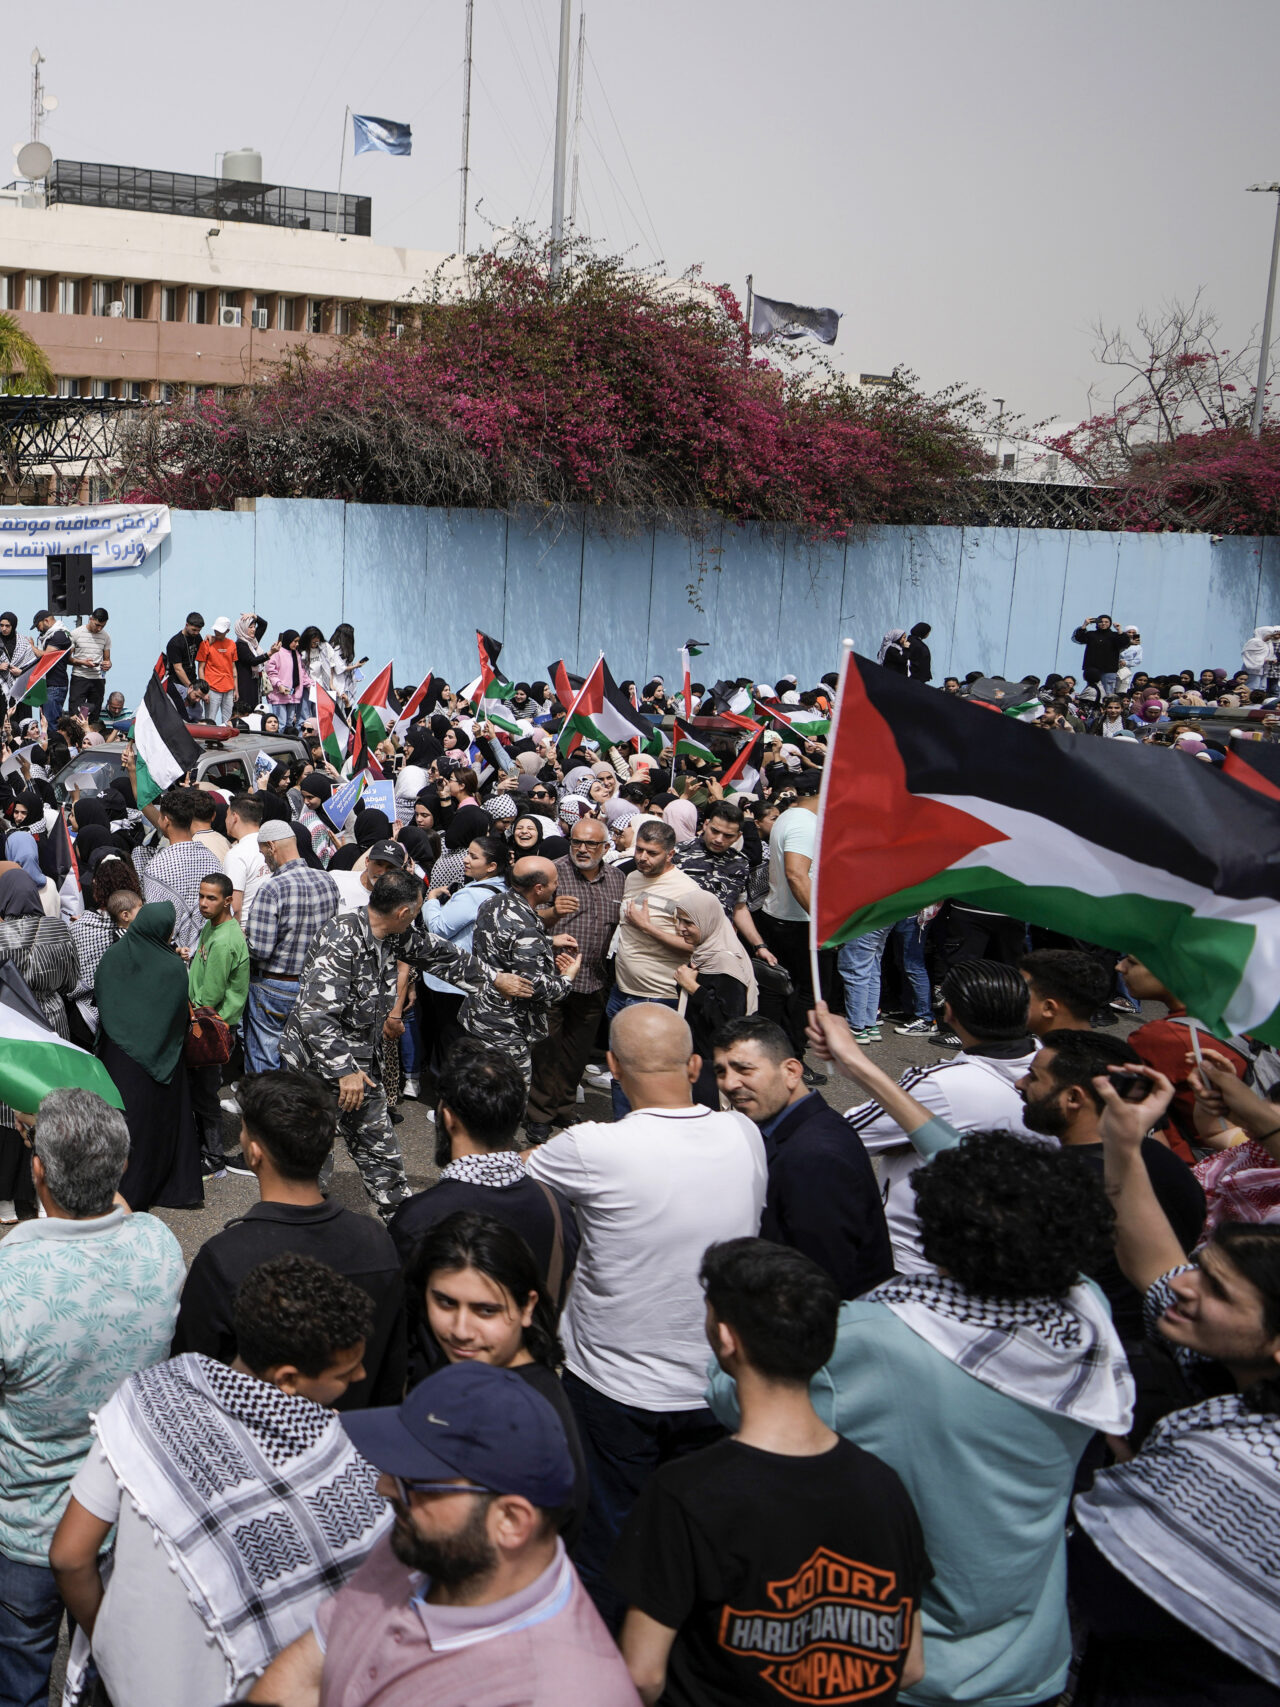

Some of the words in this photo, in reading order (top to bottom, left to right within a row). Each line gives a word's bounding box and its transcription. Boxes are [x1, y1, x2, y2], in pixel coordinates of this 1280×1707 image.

[55, 516, 111, 535] معاقبة
[116, 513, 159, 533] نرفض
[787, 1557, 876, 1609] MOTOR
[731, 1605, 904, 1654] HARLEY-DAVIDS
[778, 1651, 880, 1696] COMPANY
